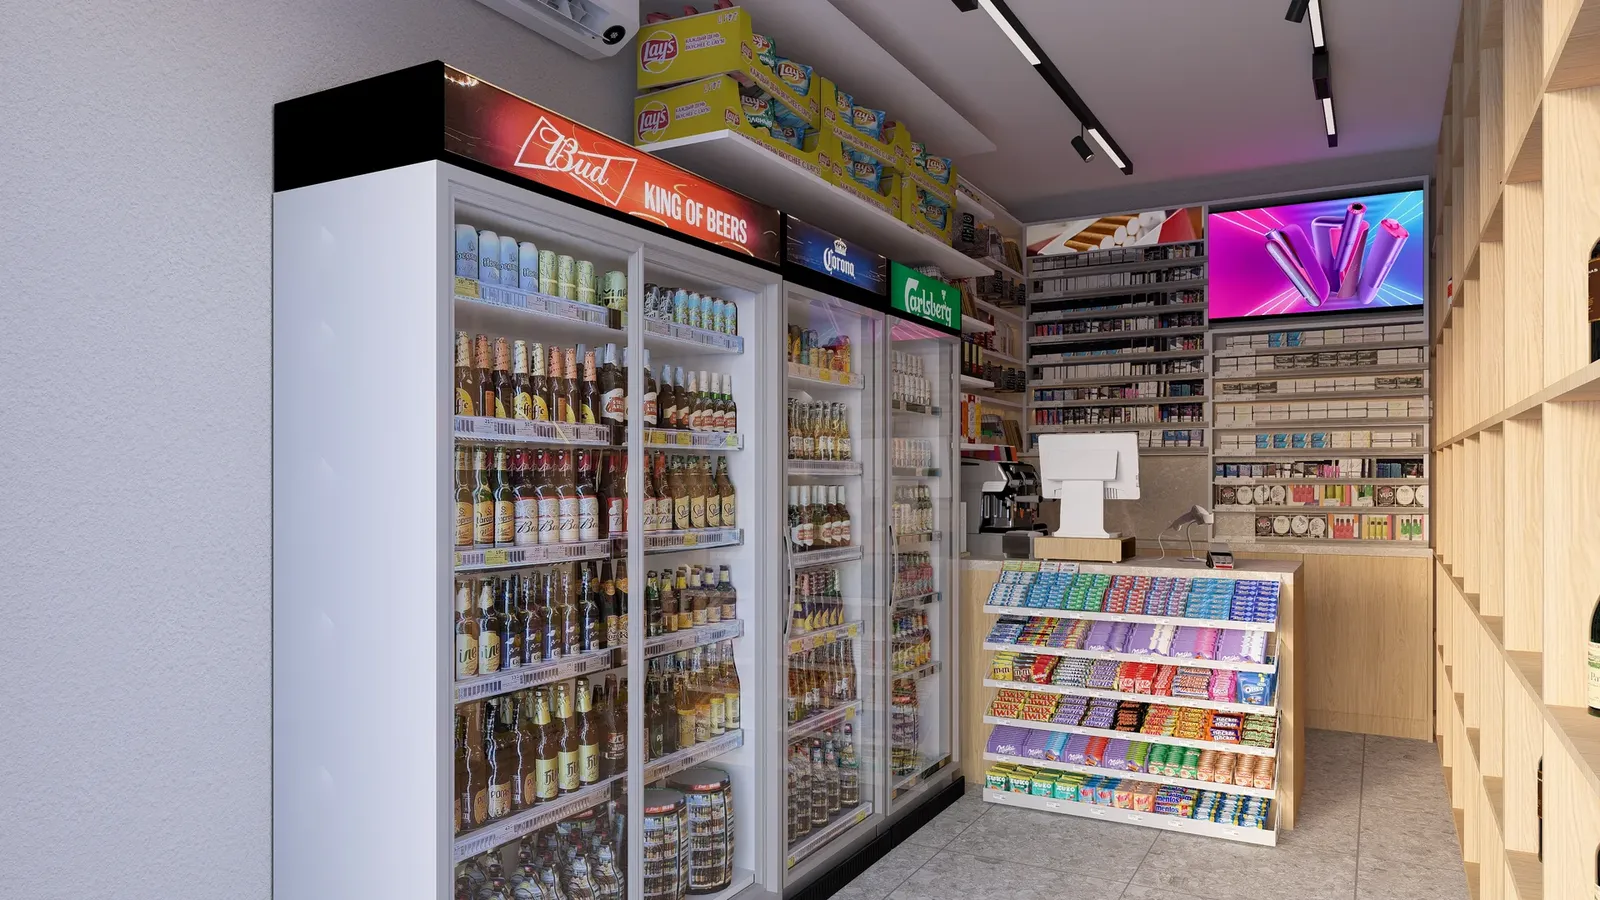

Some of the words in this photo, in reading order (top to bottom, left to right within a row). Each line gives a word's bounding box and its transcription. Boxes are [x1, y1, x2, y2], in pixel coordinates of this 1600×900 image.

[539, 127, 610, 187] Bud
[644, 180, 682, 221] KING
[685, 198, 704, 227] OF
[706, 205, 748, 245] BEERS
[823, 247, 856, 279] Corona
[904, 277, 952, 327] Carlsberg
[992, 708, 1016, 717] TWIX
[1023, 712, 1048, 720] TWIX
[1156, 804, 1179, 813] mentos
